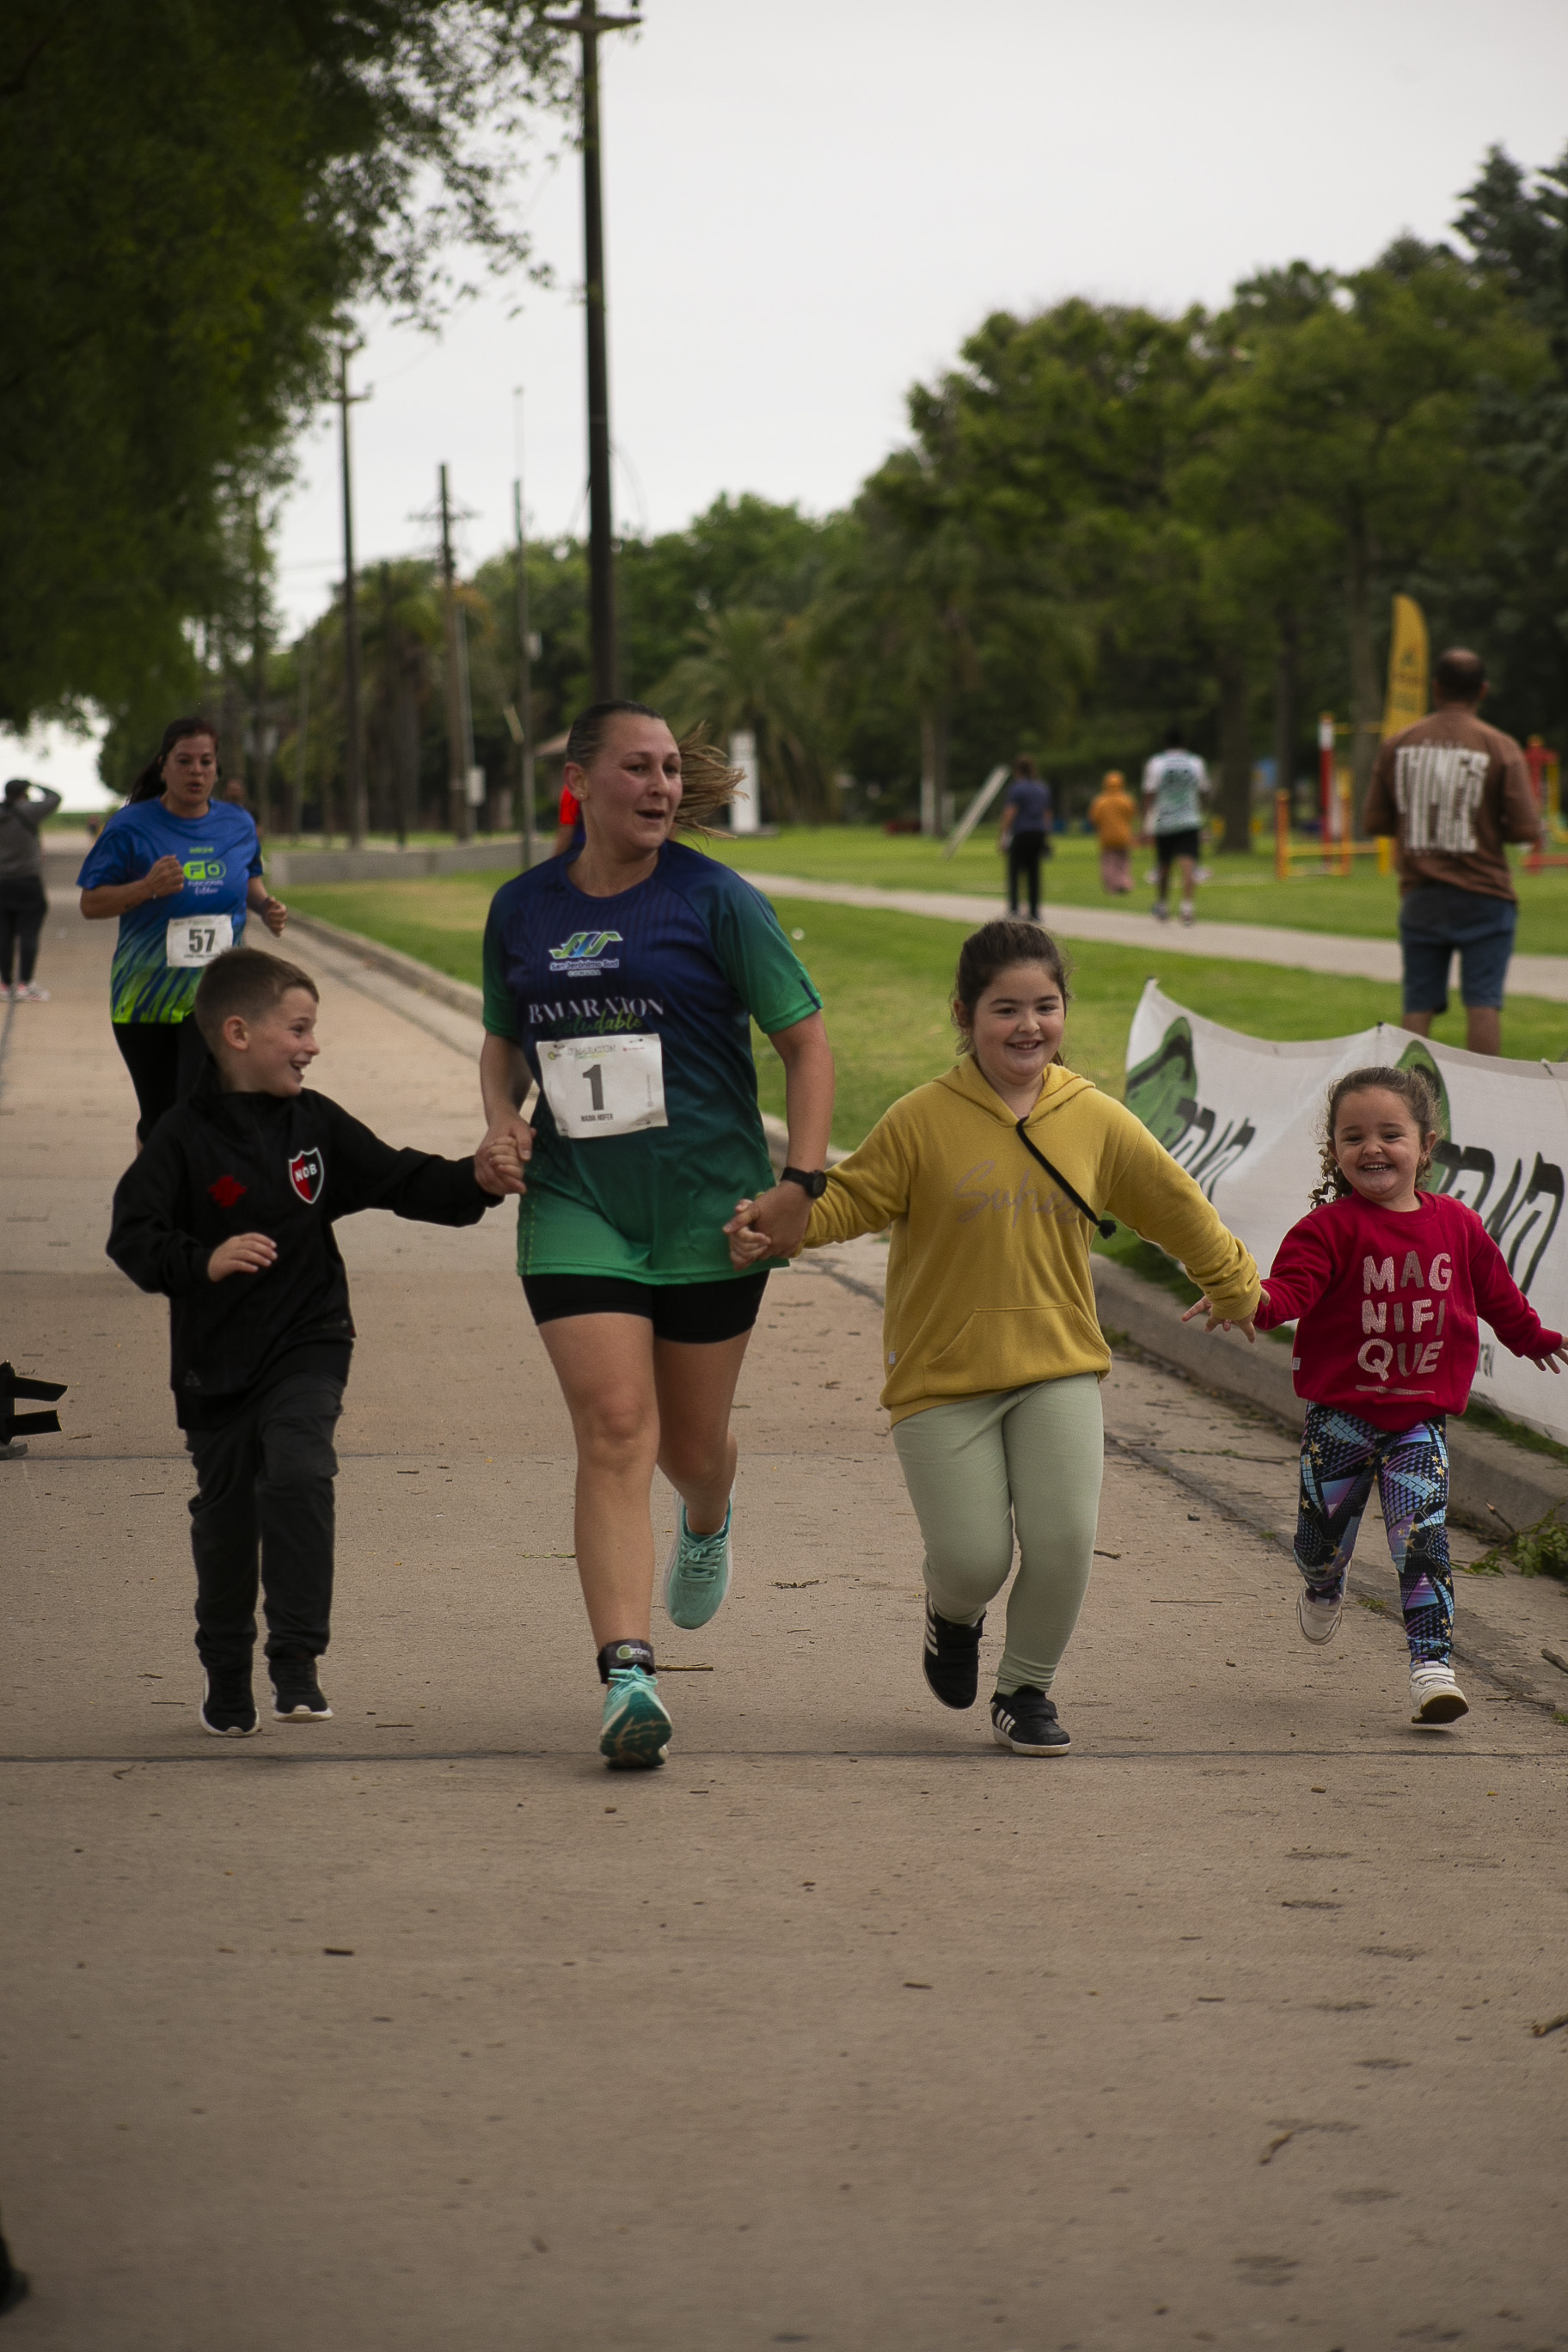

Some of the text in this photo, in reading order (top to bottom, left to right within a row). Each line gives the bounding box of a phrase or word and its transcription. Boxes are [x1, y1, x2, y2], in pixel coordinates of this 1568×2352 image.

[188, 929, 216, 953] 57
[582, 1063, 605, 1112] 1
[294, 1162, 318, 1183] NOB
[1363, 1250, 1453, 1295] MAG
[1361, 1298, 1446, 1335] NIFI
[1357, 1338, 1444, 1381] QUE
